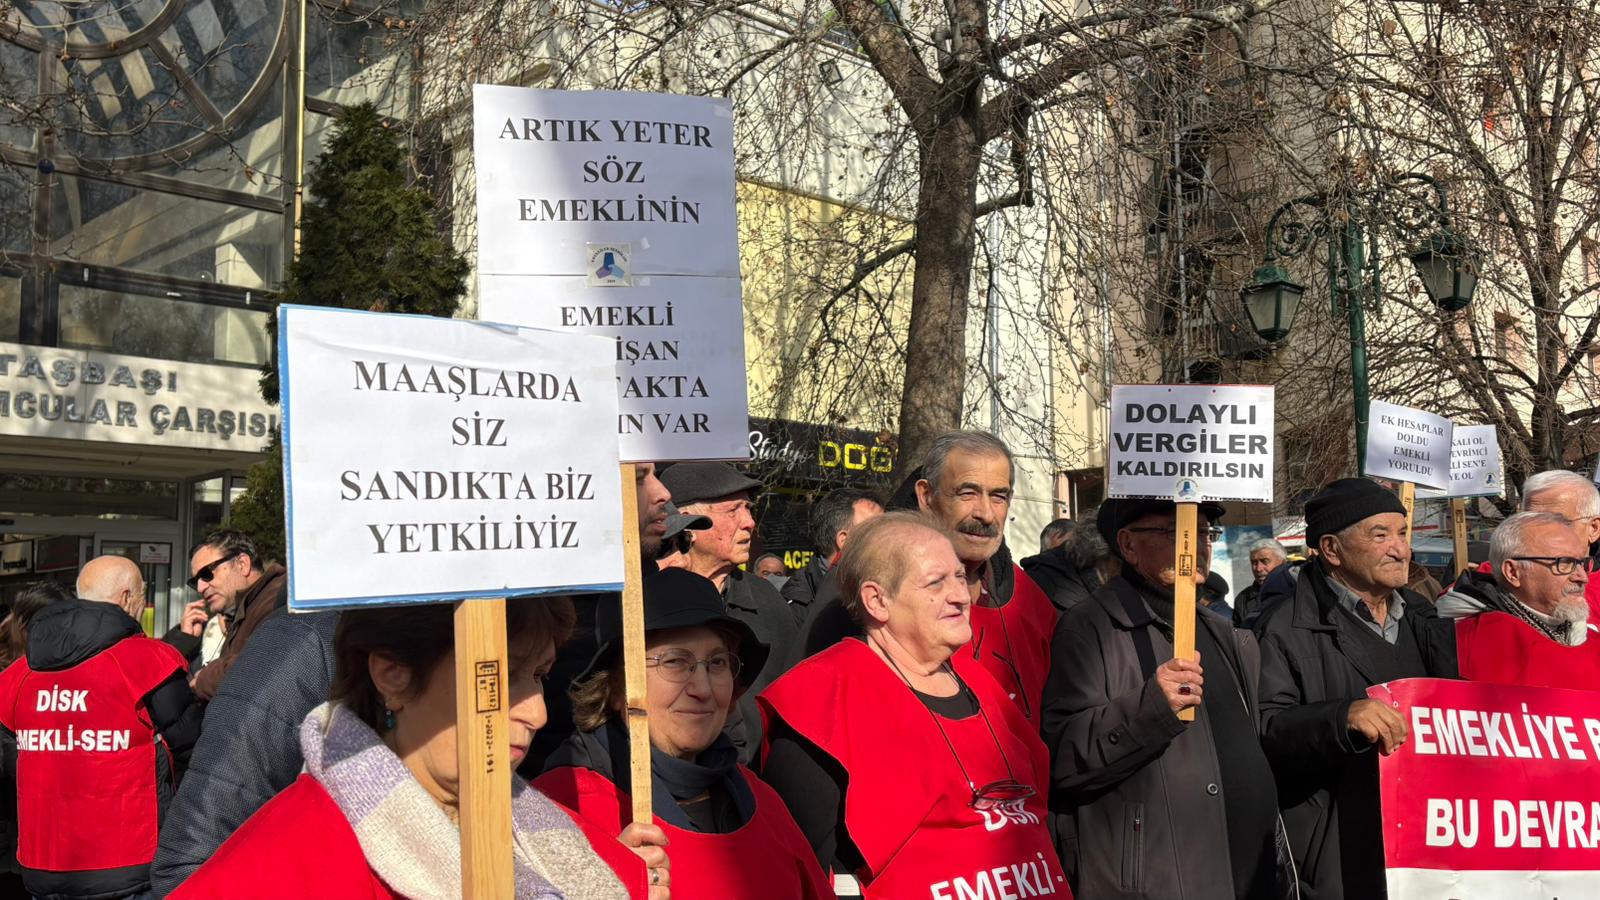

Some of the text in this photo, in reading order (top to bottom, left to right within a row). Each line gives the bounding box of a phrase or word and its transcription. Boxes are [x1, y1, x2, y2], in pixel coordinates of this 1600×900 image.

[499, 117, 713, 148] ARTIK YETER
[583, 155, 645, 183] SÖZ
[518, 194, 700, 224] EMEKLİNİN
[560, 301, 675, 326] EMEKLİ
[616, 335, 679, 366] İŞAN
[352, 360, 582, 402] MAAŞLARDA
[616, 375, 709, 398] AKTA
[617, 413, 711, 434] IN VAR
[1126, 403, 1256, 425] DOLAYLI
[1381, 415, 1444, 437] EK HESAPLAR
[451, 411, 507, 447] SİZ
[1113, 428, 1268, 454] VERGİLER
[1397, 432, 1429, 446] DOLDU
[1452, 437, 1486, 446] KALI OL
[1393, 446, 1430, 462] EMEKLİ
[1449, 446, 1488, 458] EVRİMCİ
[1117, 460, 1264, 478] KALDIRILSIN
[1388, 459, 1433, 477] YORULDU
[1461, 472, 1475, 480] OL
[340, 466, 595, 501] SANDIKTA BİZ
[366, 514, 579, 554] YETKİLİYİZ
[784, 550, 815, 570] ACE
[36, 684, 88, 712] DİSK
[16, 724, 130, 752] MEKLİ-SEN
[1411, 702, 1587, 761] EMEKLİYE
[1425, 798, 1479, 848] BU
